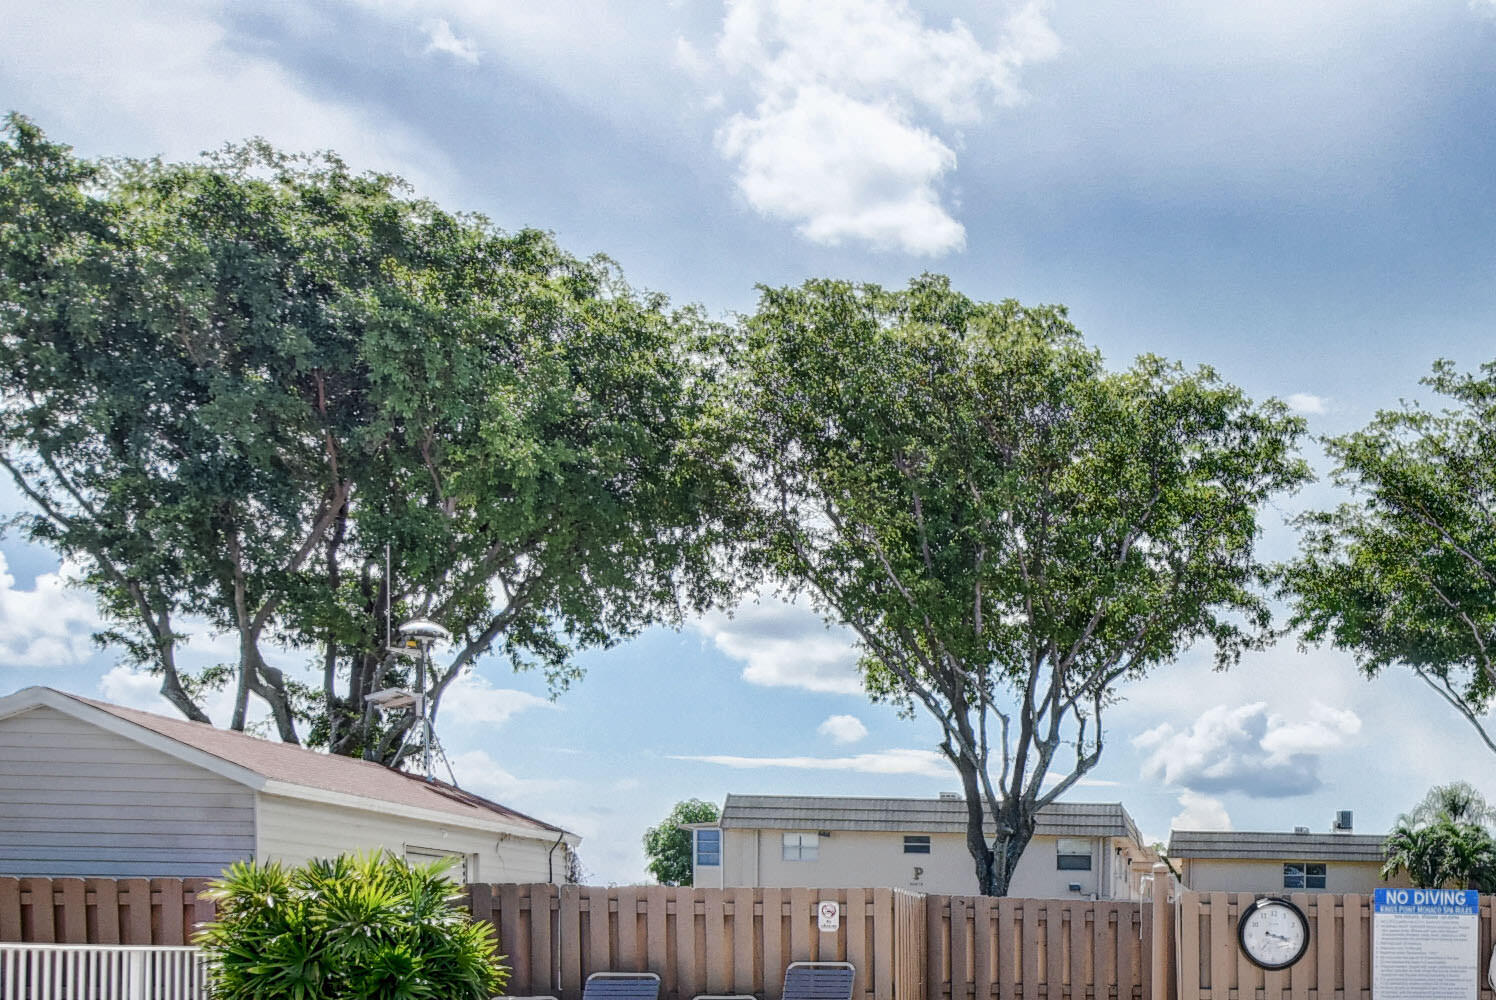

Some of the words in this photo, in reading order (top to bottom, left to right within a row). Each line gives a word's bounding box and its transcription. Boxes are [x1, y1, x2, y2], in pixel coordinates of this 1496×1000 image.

[913, 867, 924, 880] P
[1386, 890, 1408, 904] NO
[1414, 890, 1466, 905] DIVING
